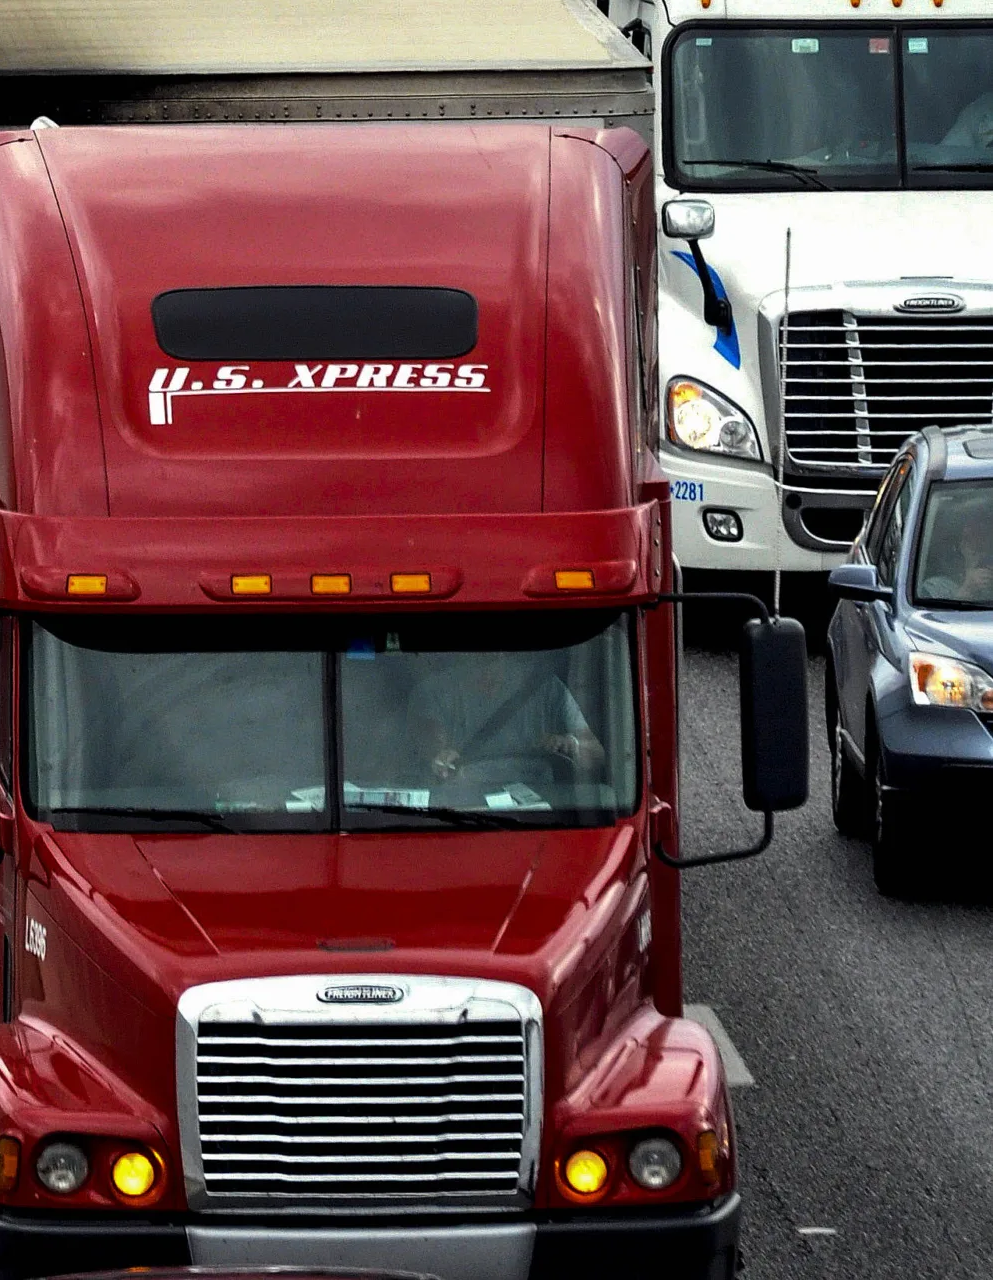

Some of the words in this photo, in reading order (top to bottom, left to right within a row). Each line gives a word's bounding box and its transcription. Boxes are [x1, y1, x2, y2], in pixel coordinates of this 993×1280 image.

[148, 366, 265, 393] U.S.
[287, 363, 490, 388] XPRESS
[326, 987, 395, 1000] FREIGHTLINER
